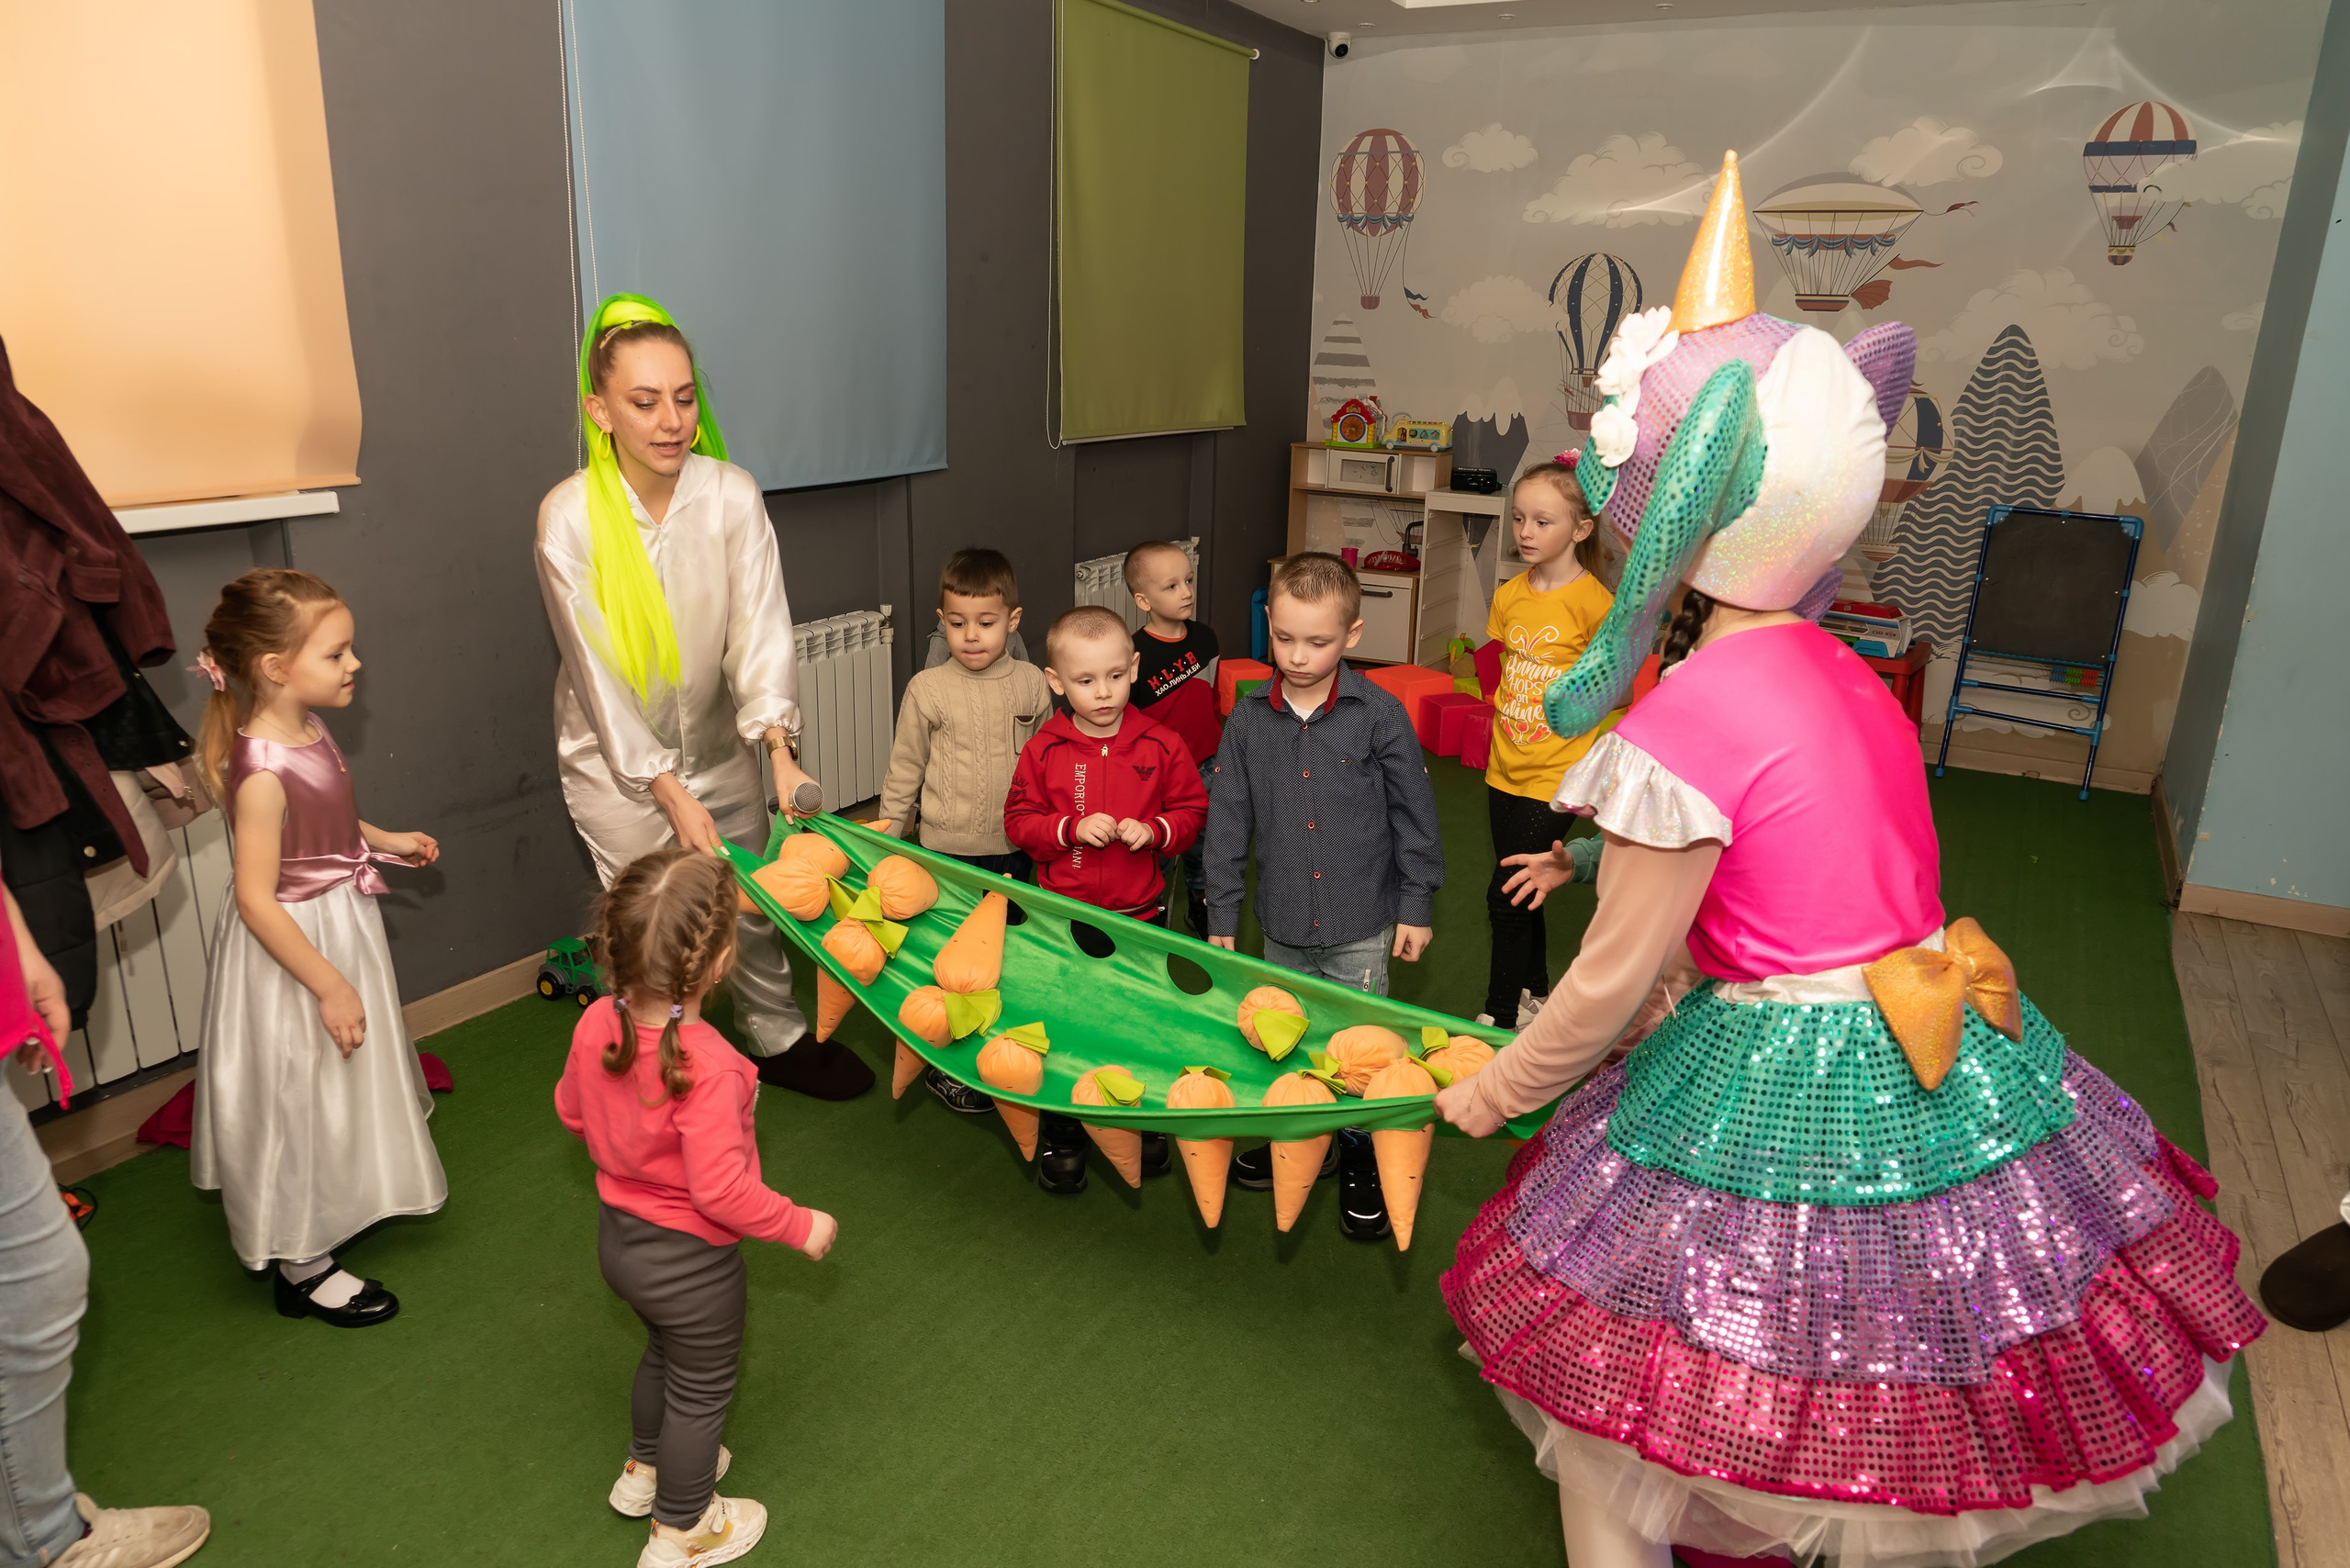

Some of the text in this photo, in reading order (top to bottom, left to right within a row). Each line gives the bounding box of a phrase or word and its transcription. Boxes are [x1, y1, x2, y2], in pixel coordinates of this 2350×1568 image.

[1516, 648, 1540, 664] This
[1505, 653, 1562, 688] Bunny
[1509, 678, 1543, 695] HOPS
[1516, 694, 1528, 703] on
[1074, 763, 1087, 812] EMPORIO
[1363, 981, 1369, 990] 6
